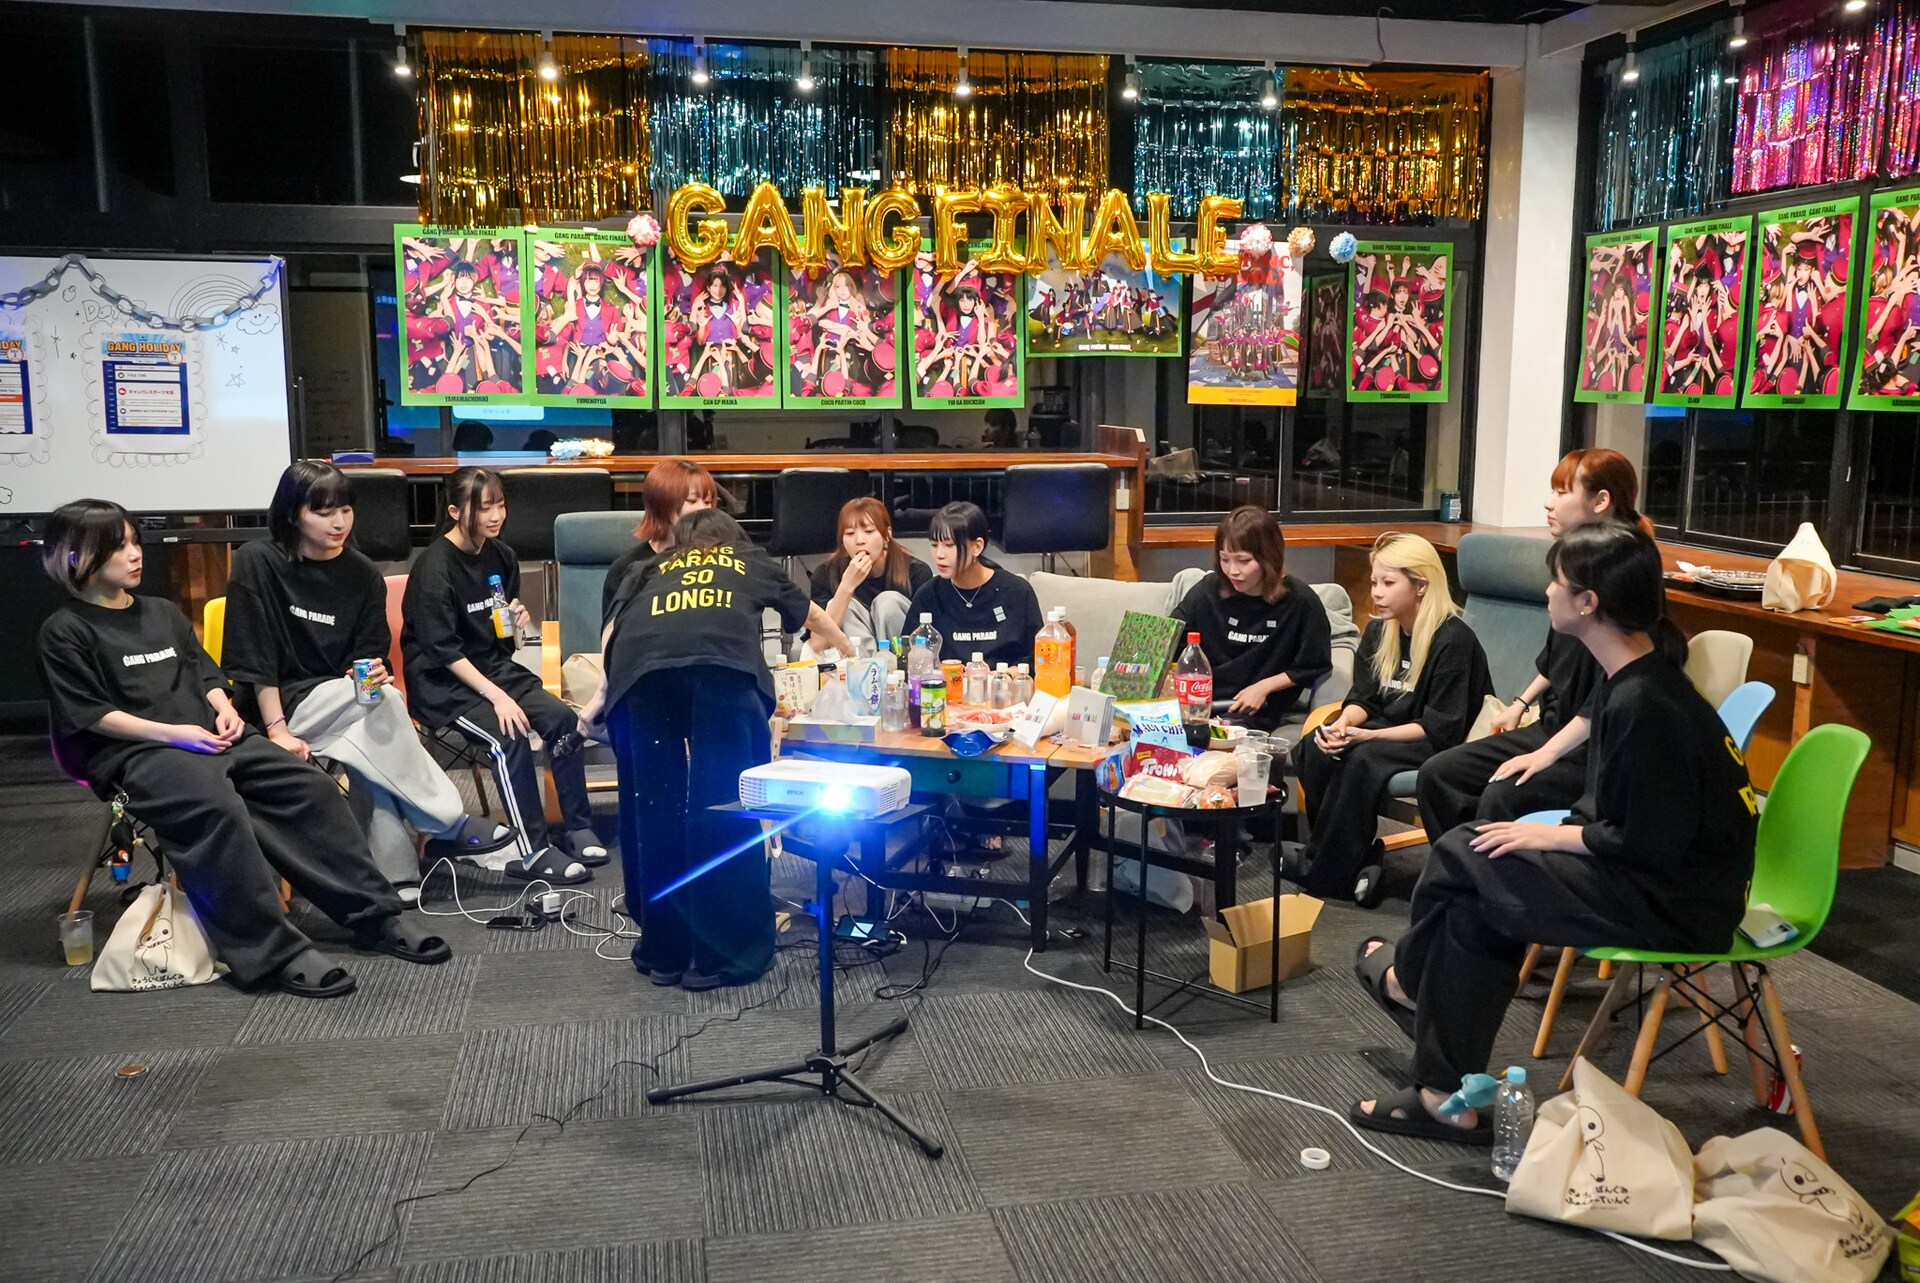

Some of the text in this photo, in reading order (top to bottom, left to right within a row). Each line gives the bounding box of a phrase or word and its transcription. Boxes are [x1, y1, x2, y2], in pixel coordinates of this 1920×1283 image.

[1790, 210, 1806, 218] PARADE
[1822, 205, 1836, 213] FINALE
[667, 181, 1245, 276] GANG FINALE
[107, 341, 182, 352] GANG HOLIDAY
[681, 569, 714, 585] SO
[467, 601, 484, 614] GANG
[651, 588, 732, 616] LONG!!
[289, 605, 336, 626] GANG PARADE
[953, 630, 998, 641] GANG PARADE
[1228, 630, 1247, 643] GANG
[122, 647, 177, 667] GANG PARADE
[1132, 722, 1160, 737] MAUI
